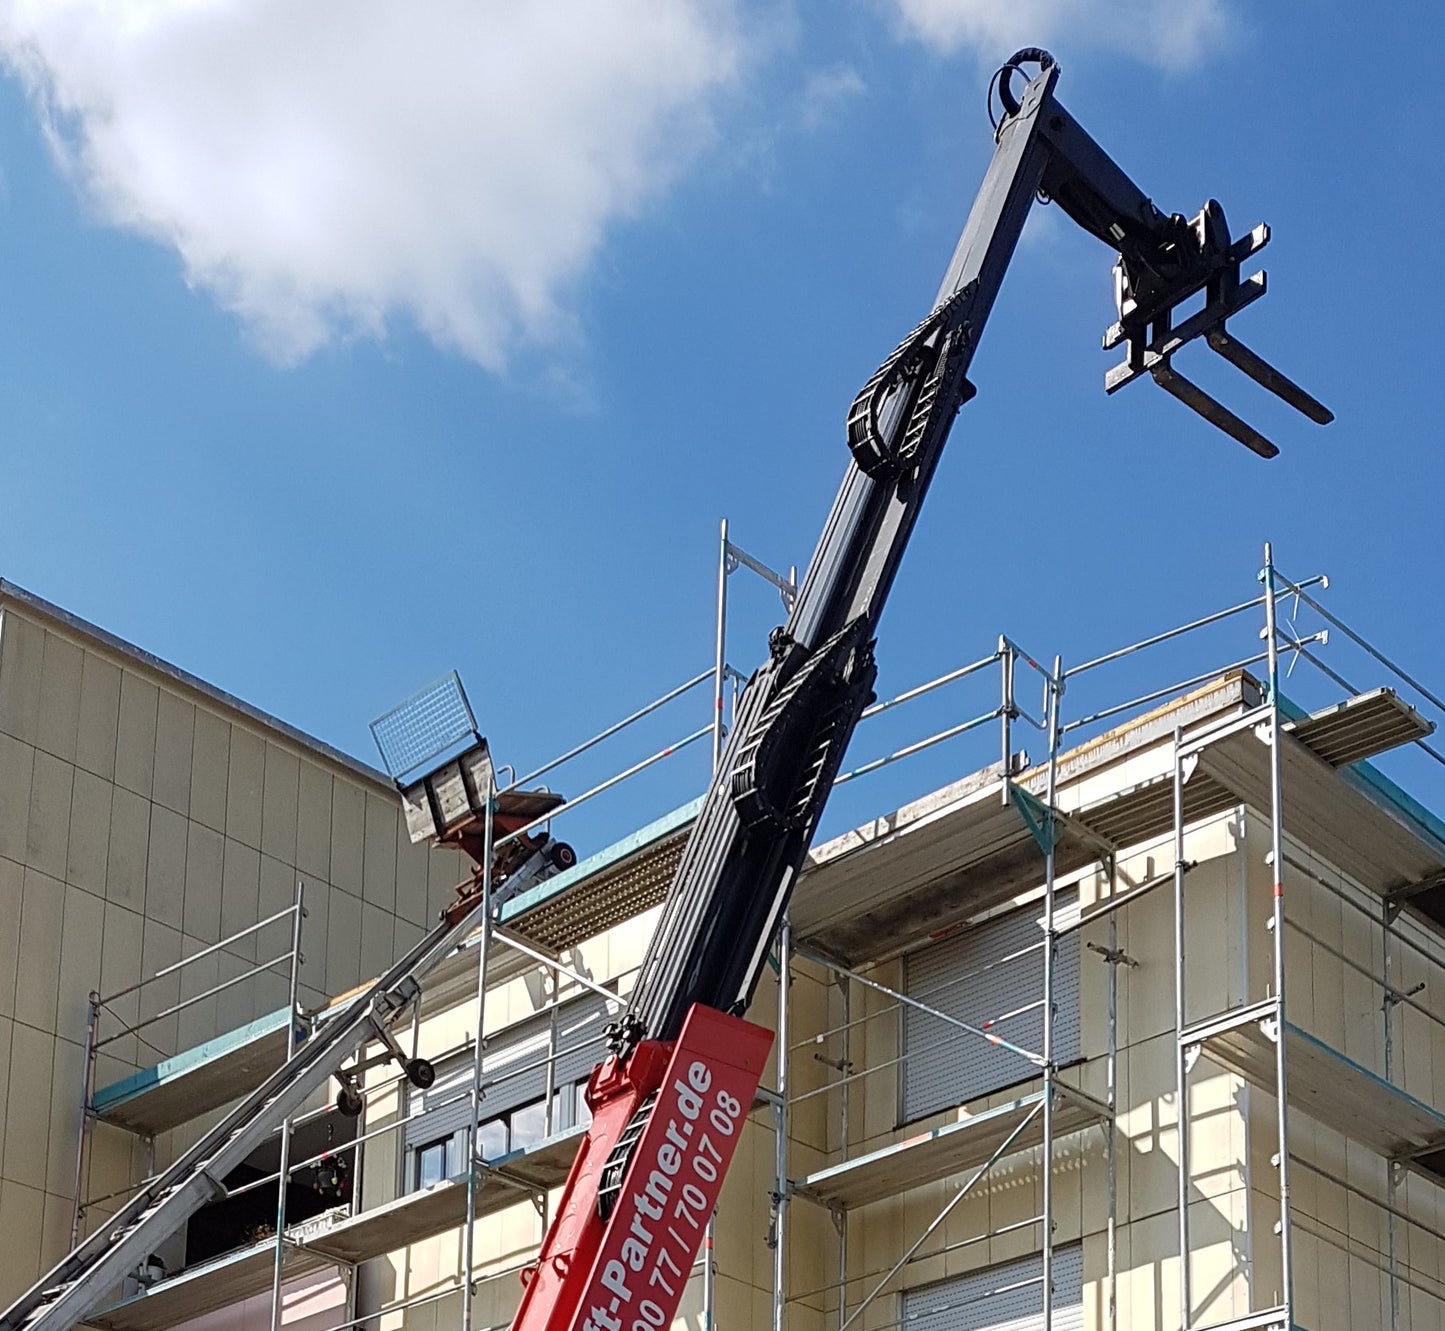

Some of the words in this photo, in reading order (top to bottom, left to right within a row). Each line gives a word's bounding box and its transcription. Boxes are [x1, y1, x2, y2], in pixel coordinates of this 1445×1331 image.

[648, 1247, 682, 1297] 77
[674, 1183, 707, 1230] 70
[692, 1133, 723, 1182] 07
[709, 1090, 741, 1136] 08
